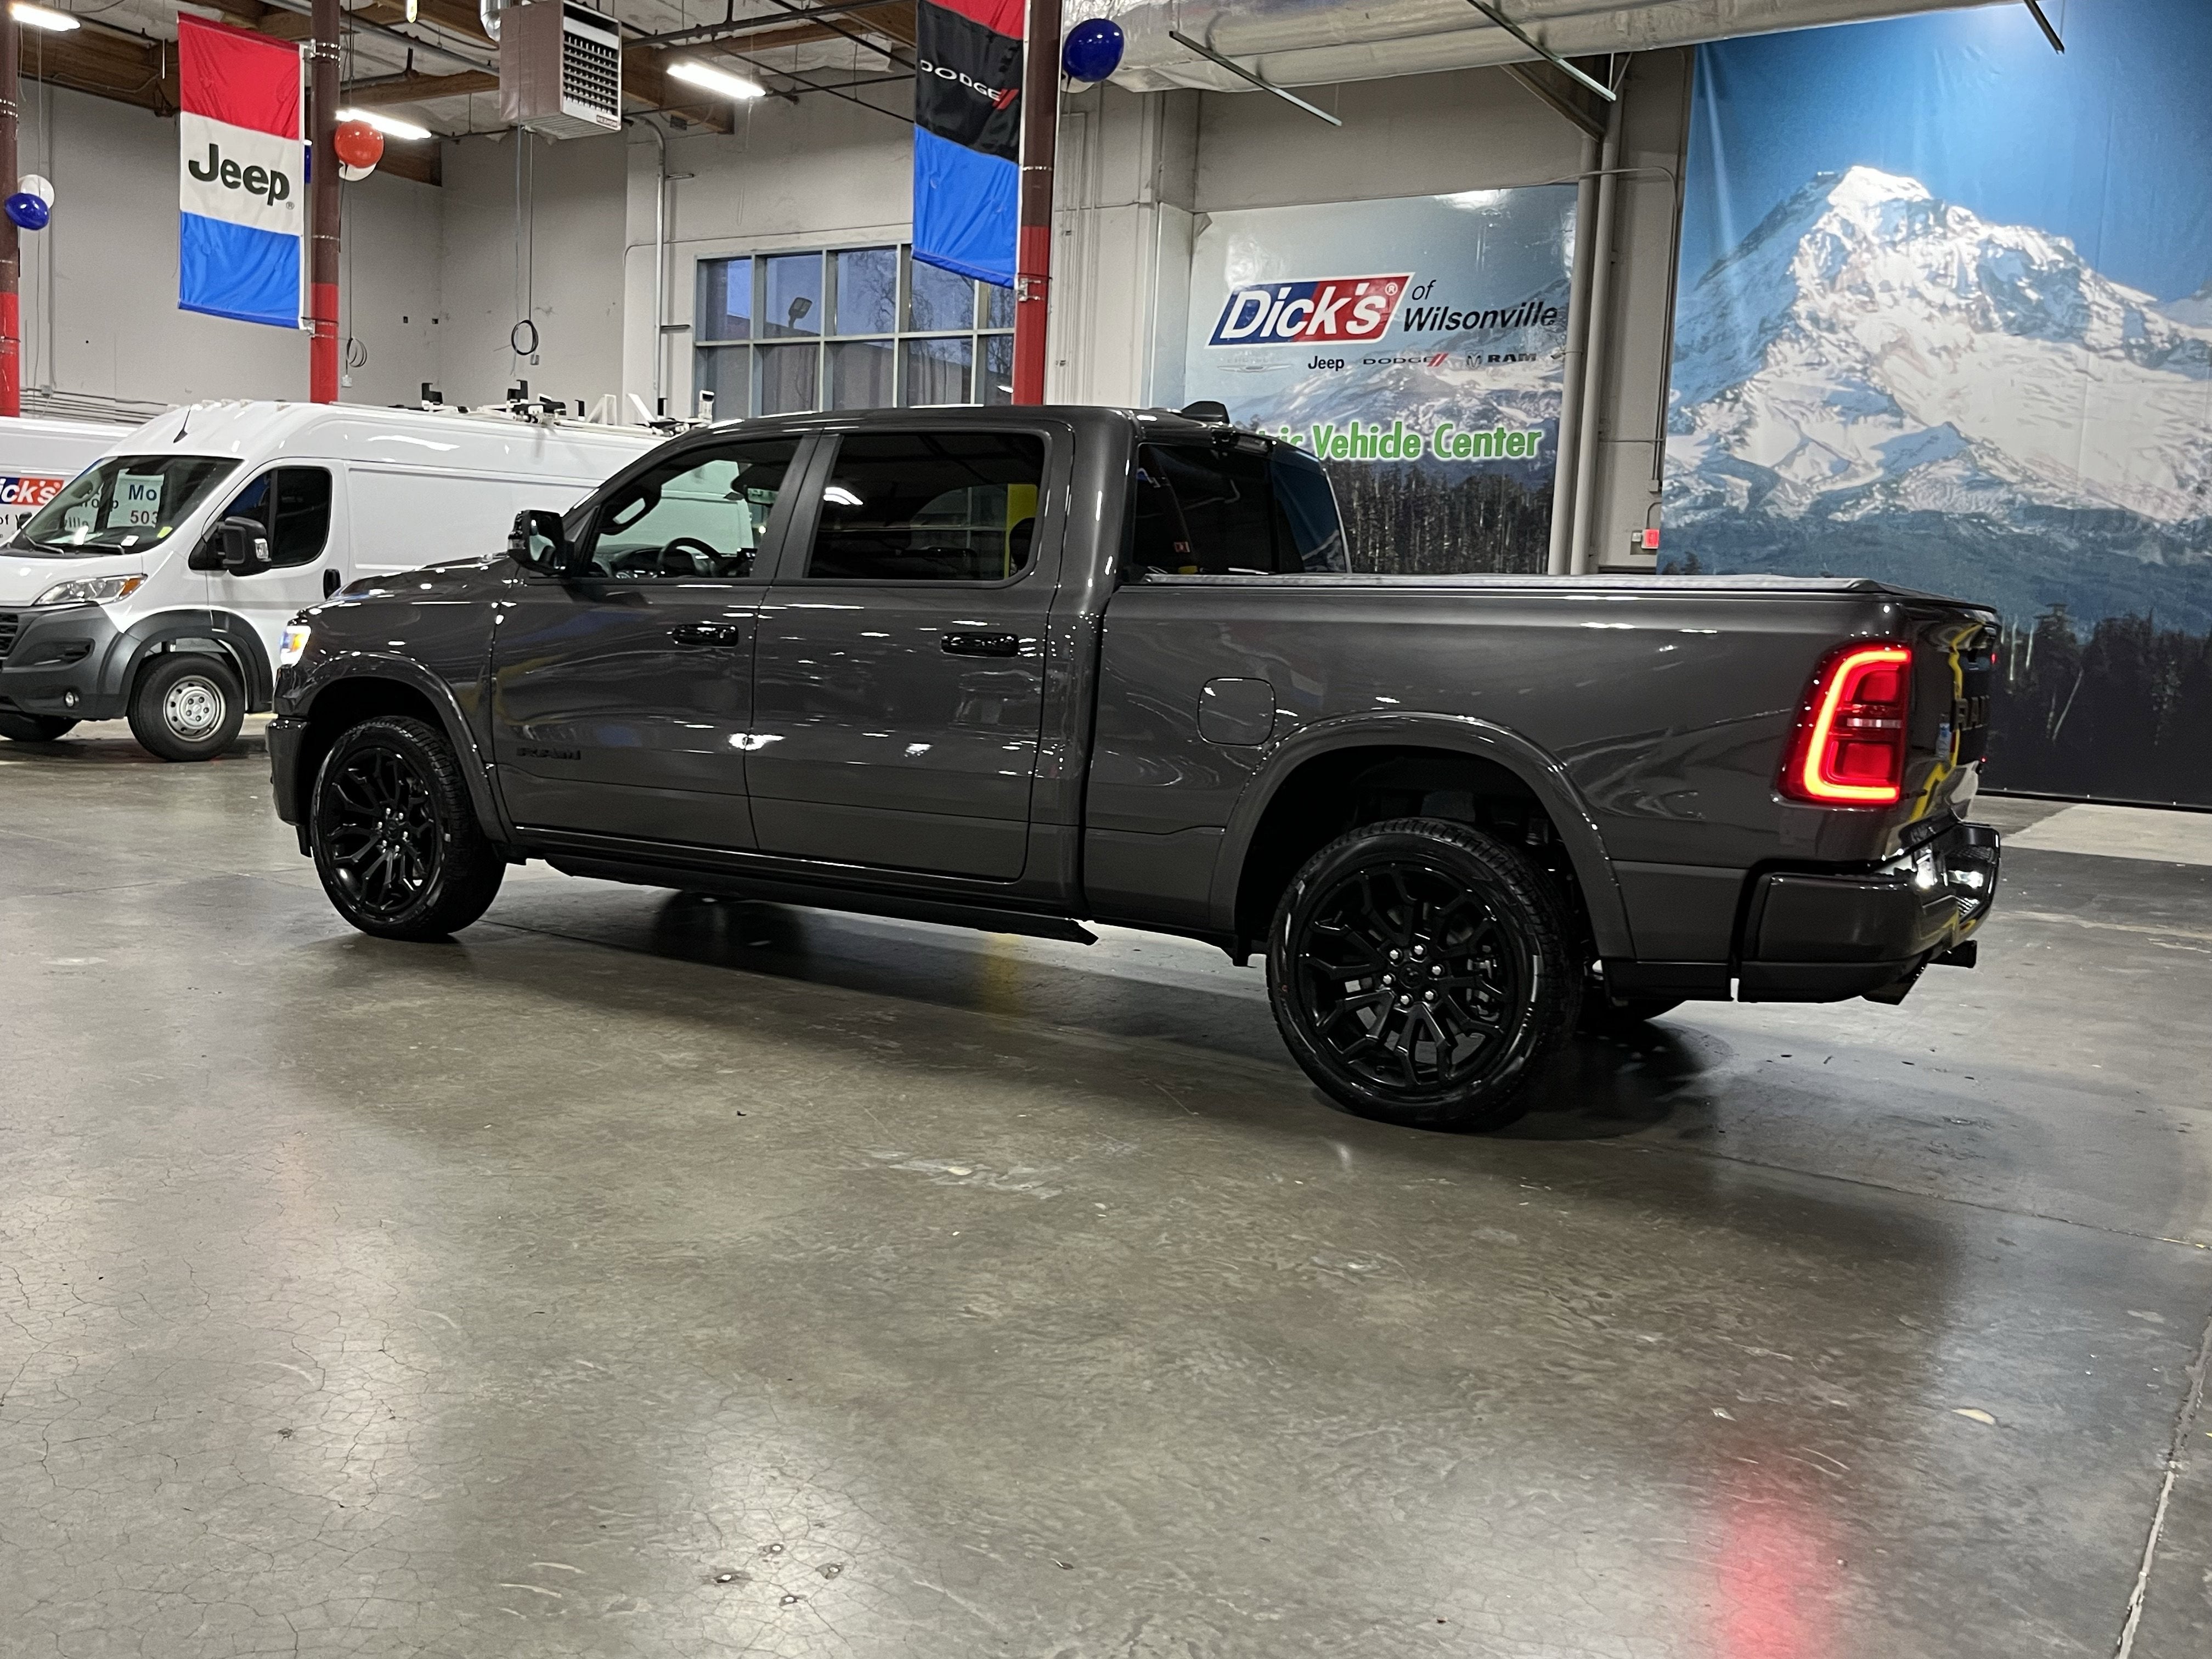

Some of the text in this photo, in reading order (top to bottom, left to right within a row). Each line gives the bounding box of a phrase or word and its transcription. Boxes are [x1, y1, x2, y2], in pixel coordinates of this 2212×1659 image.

[919, 59, 1002, 101] DODGE
[188, 143, 290, 206] Jeep
[1411, 279, 1437, 300] of
[1220, 282, 1387, 339] Dick's
[1402, 301, 1558, 332] Wilsonville
[1308, 356, 1345, 371] Jeep
[1363, 356, 1431, 365] DODGE
[1487, 353, 1537, 363] RAM
[1313, 421, 1421, 459] Vehicle
[1434, 423, 1542, 459] Center
[0, 478, 56, 504] ick's
